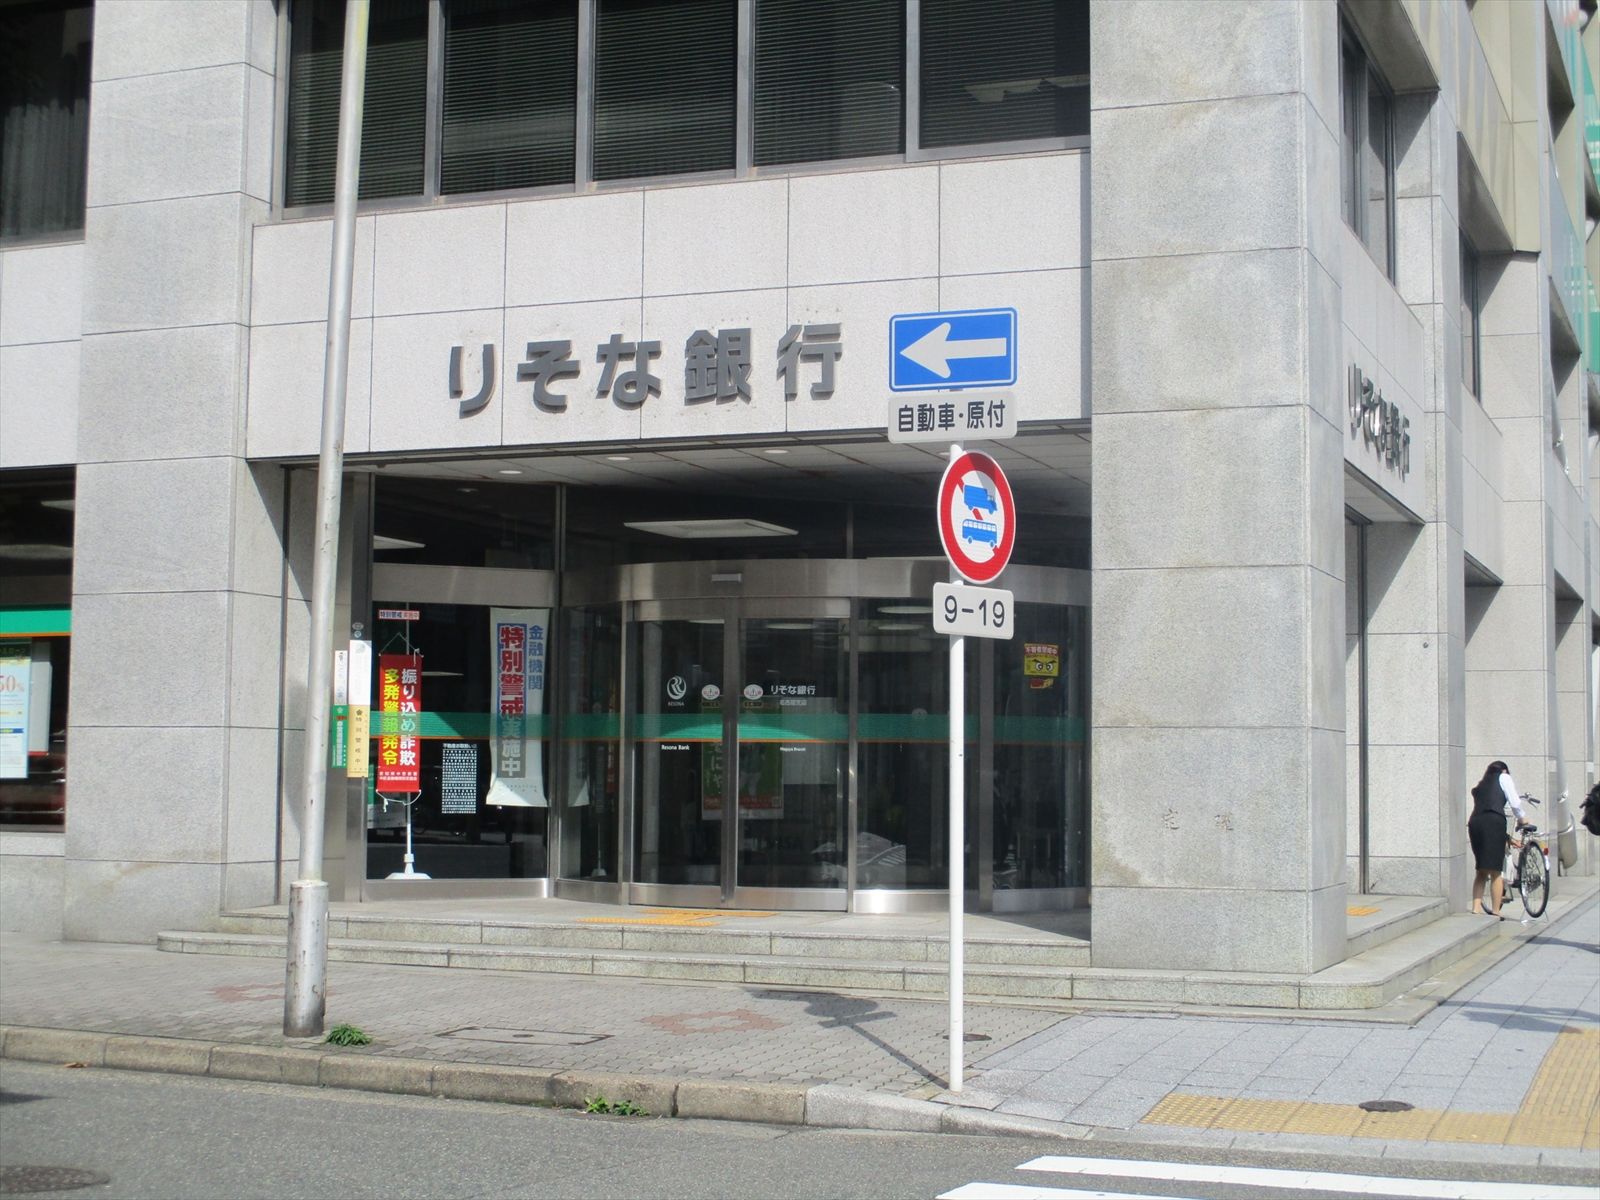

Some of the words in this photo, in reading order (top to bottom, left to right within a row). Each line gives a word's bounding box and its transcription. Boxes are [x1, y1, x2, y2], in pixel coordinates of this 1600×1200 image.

[449, 322, 843, 419] りそな銀行
[528, 624, 544, 690] 金融機関
[944, 594, 1006, 629] 9-19
[382, 668, 400, 766] 多発警報発令
[399, 668, 418, 767] 振り込め詐欺
[500, 625, 525, 777] 特別警戒実施中
[770, 685, 816, 696] りそな銀行
